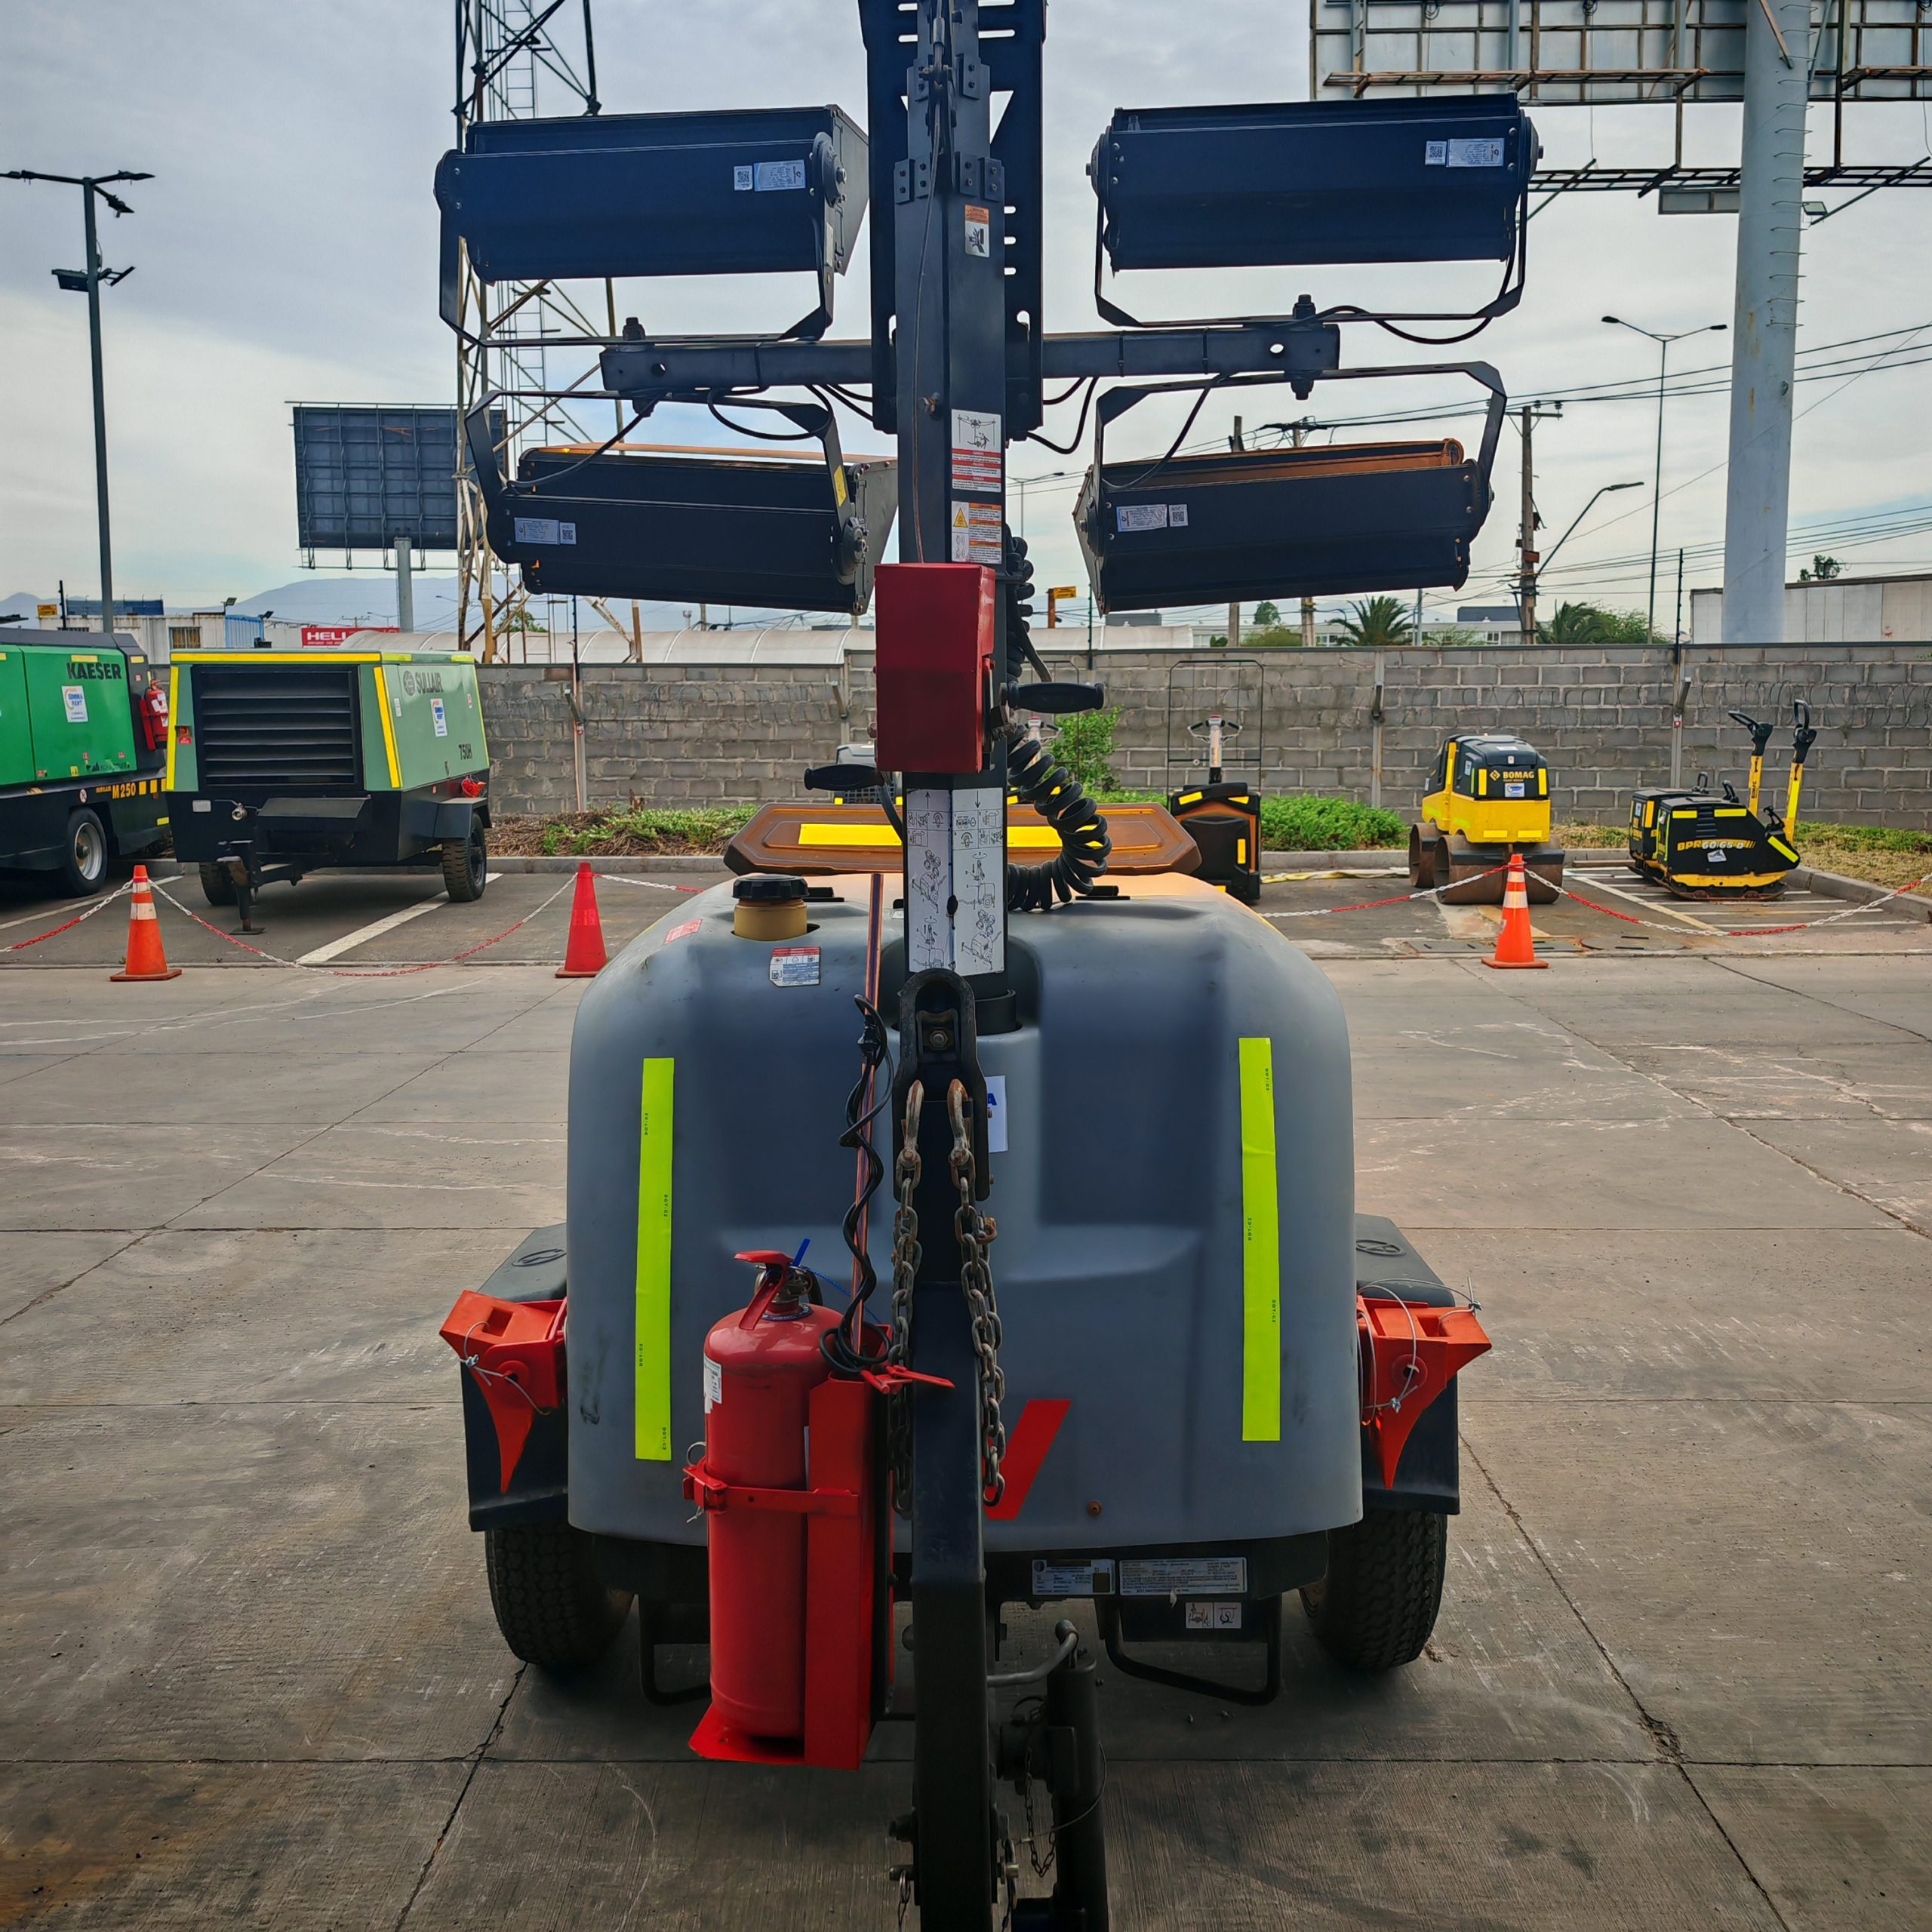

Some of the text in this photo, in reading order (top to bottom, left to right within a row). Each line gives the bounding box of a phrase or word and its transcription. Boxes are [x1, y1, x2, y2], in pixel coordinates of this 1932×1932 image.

[66, 663, 122, 680] KAESER
[414, 672, 444, 694] SULLAIR
[1677, 839, 1702, 851] BPR
